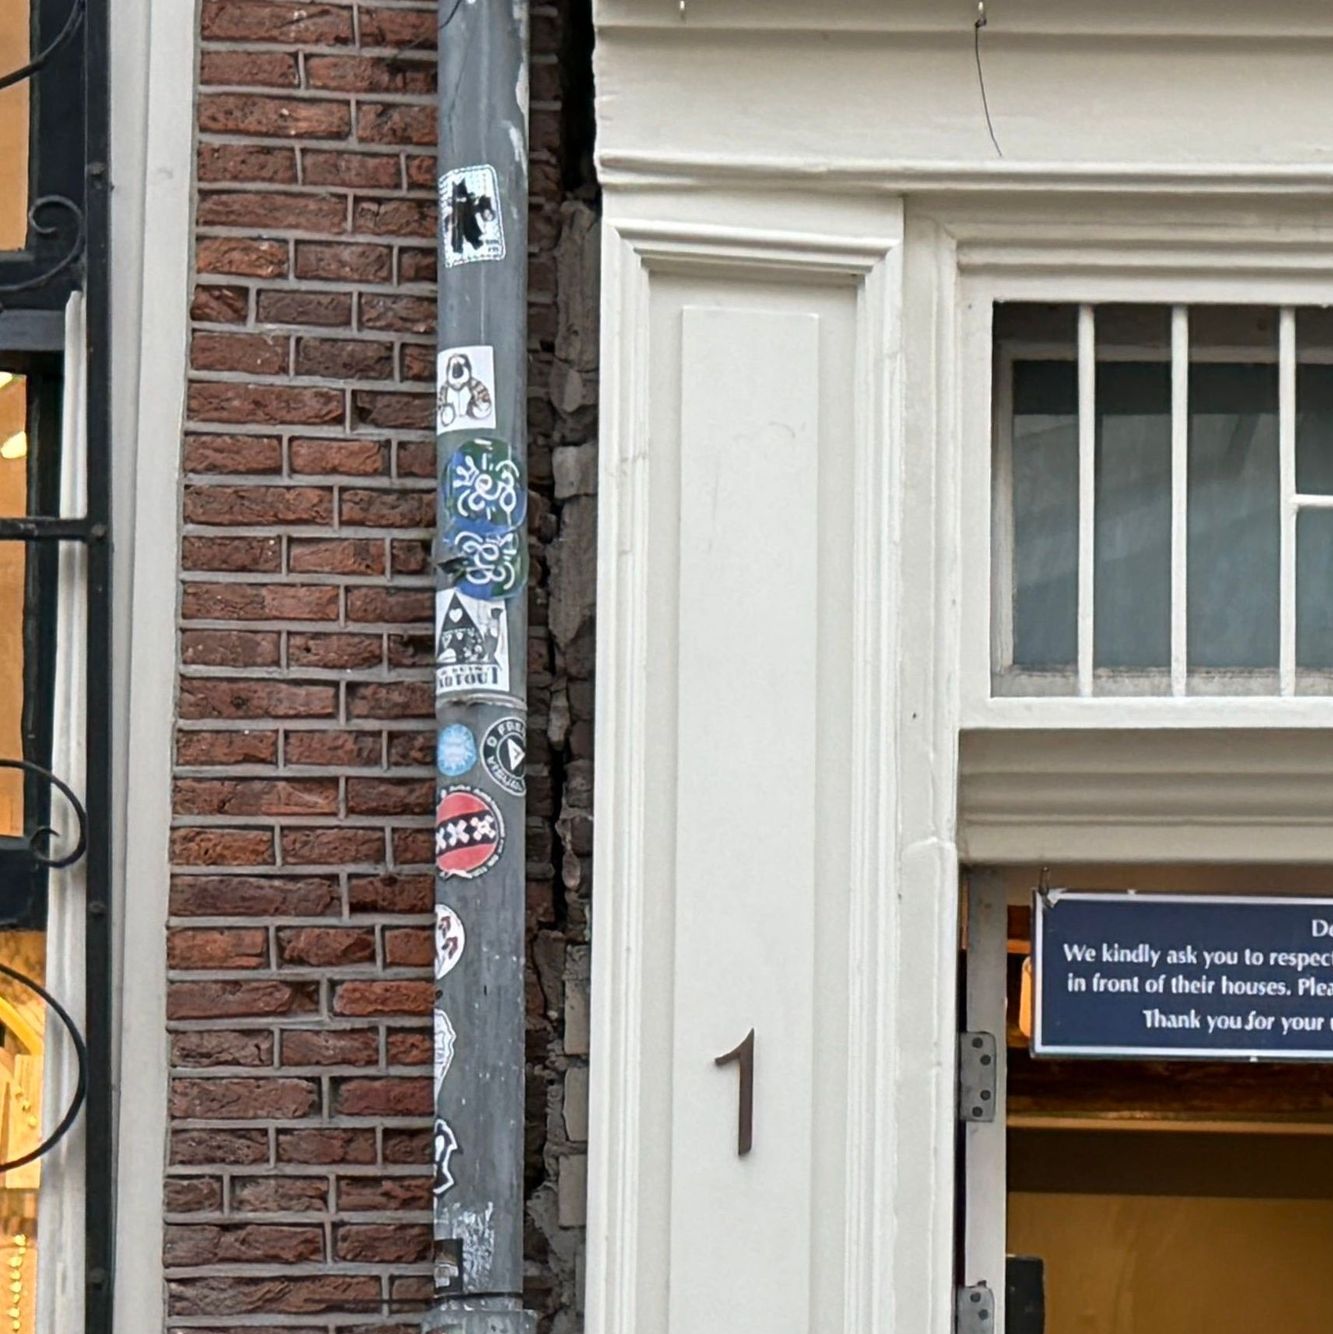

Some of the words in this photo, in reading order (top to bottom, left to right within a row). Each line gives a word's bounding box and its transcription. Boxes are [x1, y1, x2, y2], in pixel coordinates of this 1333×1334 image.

[1063, 943, 1097, 962] We
[1101, 942, 1162, 968] kindly
[1166, 944, 1198, 965] ask
[1202, 950, 1239, 970] you
[1244, 948, 1265, 966] to
[1067, 972, 1087, 993] in
[1092, 972, 1140, 993] front
[1144, 973, 1167, 994] of
[1170, 973, 1216, 995] their
[1220, 974, 1292, 996] houses.
[1142, 1008, 1201, 1029] Thank
[1206, 1014, 1243, 1034] you
[1243, 1009, 1276, 1031] for
[1280, 1016, 1325, 1036] your
[714, 1027, 755, 1156] 1
